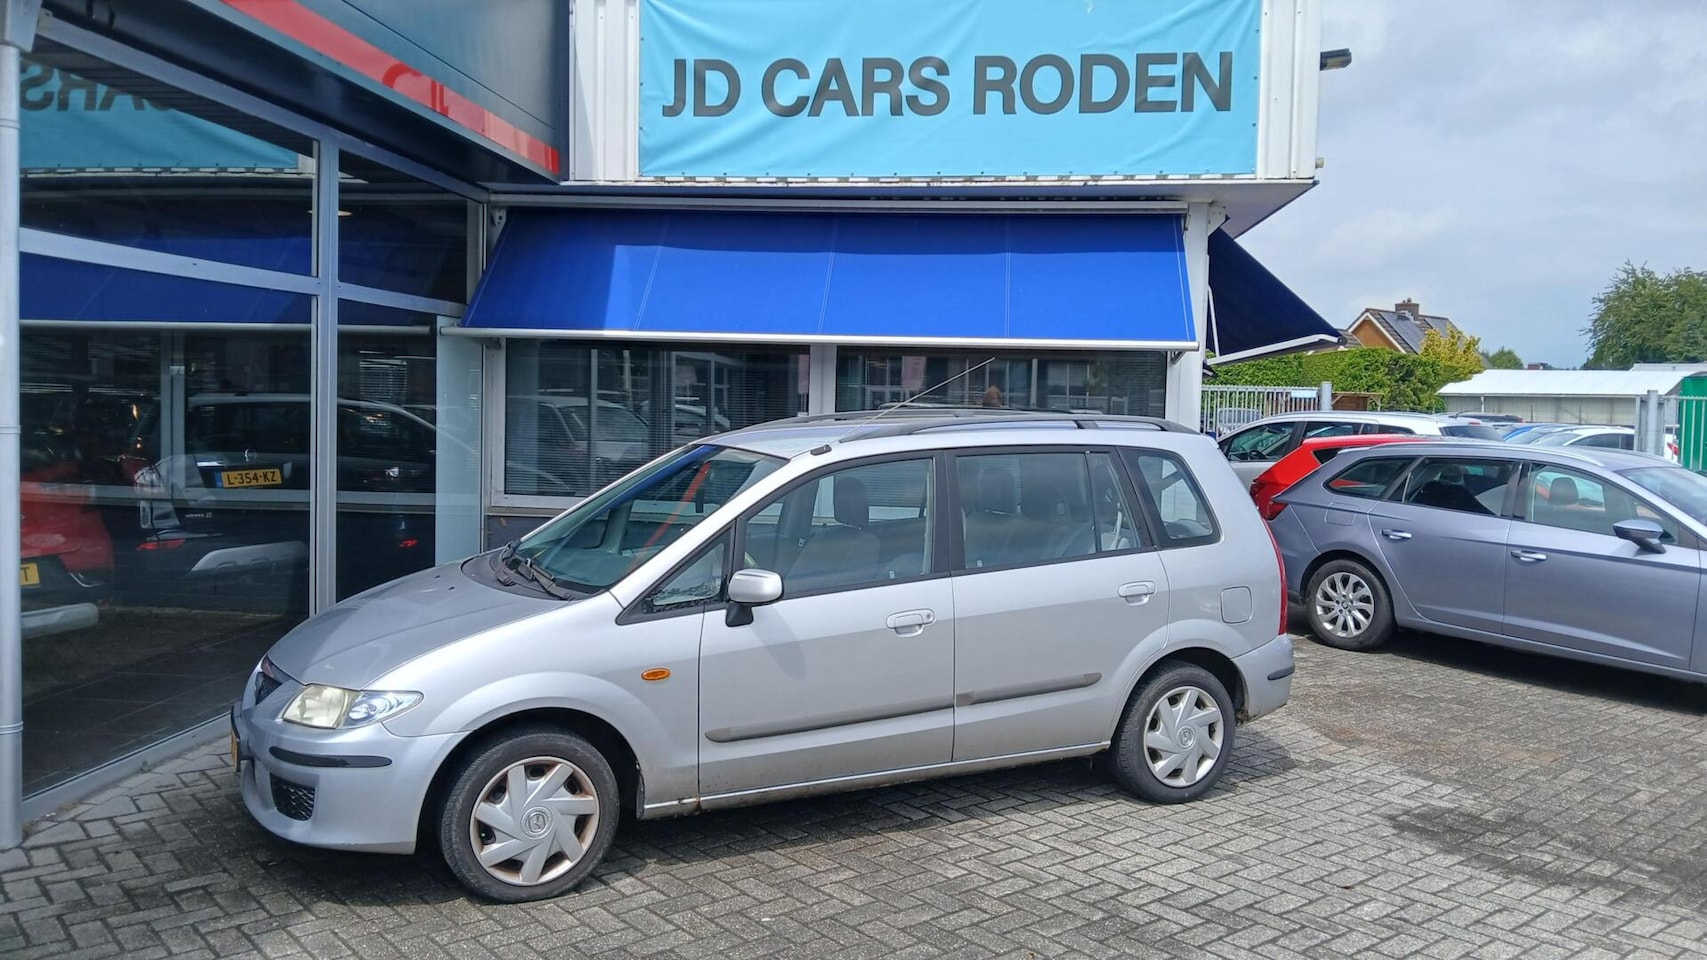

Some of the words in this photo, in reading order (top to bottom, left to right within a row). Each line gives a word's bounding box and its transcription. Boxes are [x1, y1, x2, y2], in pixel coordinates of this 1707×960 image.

[662, 59, 741, 117] JD
[761, 56, 950, 117] CARS
[973, 52, 1233, 115] RODEN
[226, 471, 277, 486] L-354-KZ
